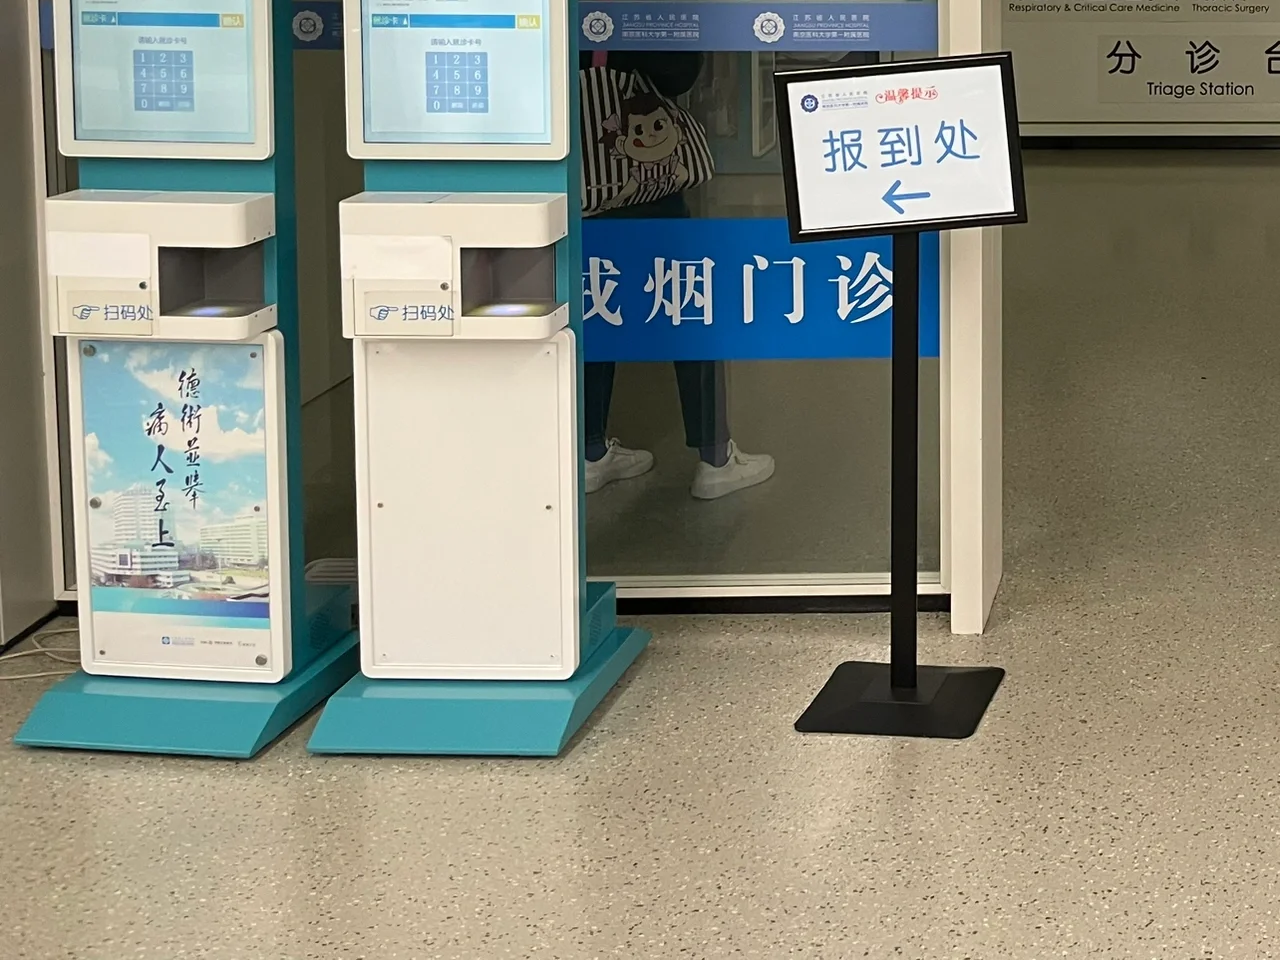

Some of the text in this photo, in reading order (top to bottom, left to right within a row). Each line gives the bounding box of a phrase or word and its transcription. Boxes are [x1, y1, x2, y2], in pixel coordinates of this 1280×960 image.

[1009, 3, 1180, 14] Respiratory & Critical Care Medicine
[1192, 3, 1270, 15] Thoracic Surgery
[878, 86, 938, 104] 温馨提示
[1147, 81, 1254, 99] Triage Station
[822, 119, 980, 173] 报到处
[103, 303, 154, 322] 扫码处
[401, 303, 455, 322] 扫码处
